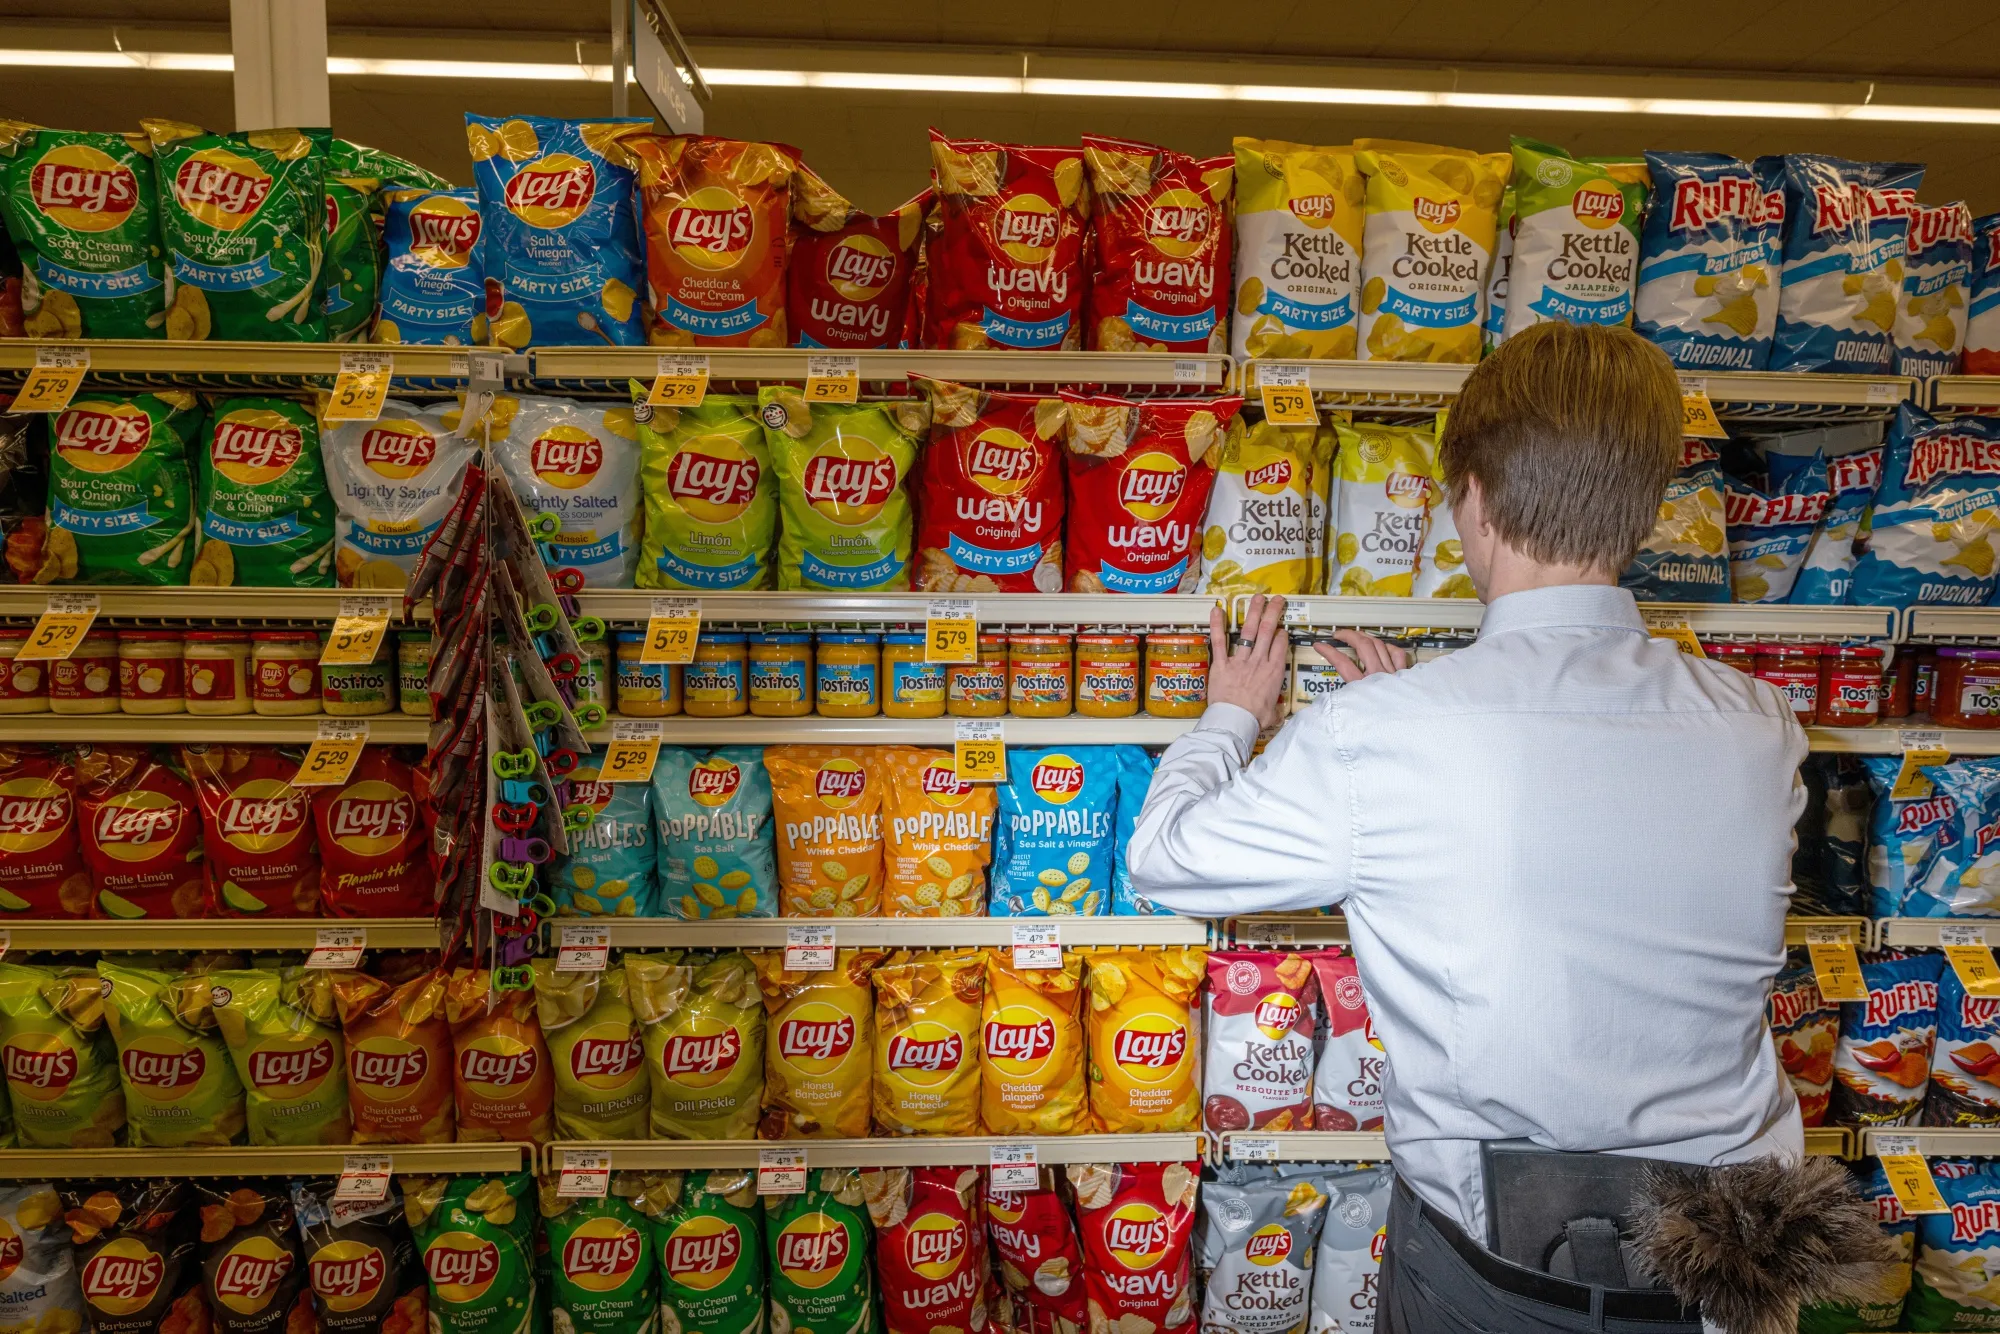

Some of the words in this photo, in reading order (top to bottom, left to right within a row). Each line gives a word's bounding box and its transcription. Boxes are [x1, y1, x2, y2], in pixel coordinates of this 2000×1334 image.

[40, 164, 130, 213] Lay's
[513, 165, 590, 209] Lay's
[1292, 195, 1334, 220] Lay's
[1575, 190, 1622, 218] Lay's
[1672, 178, 1785, 230] RUFFLES
[673, 206, 750, 252] Lay's
[47, 237, 82, 249] Sour
[85, 239, 133, 252] Cream
[530, 235, 555, 247] Salt
[557, 236, 567, 246] &
[1284, 232, 1345, 260] Kettle
[1560, 232, 1630, 260] Kettle
[63, 249, 75, 260] &
[77, 250, 121, 263] Onion
[526, 247, 573, 260] Vinegar
[830, 247, 889, 286] Lay's
[1271, 257, 1350, 283] Cooked
[1547, 257, 1632, 282] Cooked
[48, 269, 101, 290] PARTY
[106, 272, 143, 290] SIZE
[512, 275, 556, 295] PARTY
[561, 275, 593, 294] SIZE
[682, 276, 725, 290] Cheddar
[728, 279, 741, 290] &
[1287, 284, 1338, 295] ORIGINAL
[1565, 282, 1621, 293] JALAPEÑO
[678, 288, 706, 300] Sour
[707, 290, 745, 302] Cream
[673, 308, 719, 329] PARTY
[723, 310, 752, 328] SIZE
[811, 298, 890, 337] wavy
[1272, 301, 1317, 321] PARTY
[1320, 304, 1346, 321] SIZE
[826, 327, 868, 342] Original
[990, 319, 1033, 339] PARTY
[1036, 322, 1065, 339] SIZE
[1679, 342, 1753, 369] ORIGINAL
[59, 410, 147, 455] Lay's
[365, 429, 435, 468] Lay's
[1908, 437, 2000, 482] RUFFLES
[972, 441, 1032, 481] Lay's
[673, 453, 757, 505] Lay's
[1248, 460, 1290, 489] Lay's
[346, 483, 395, 500] Lightly
[399, 484, 440, 499] Salted
[573, 495, 618, 509] Salted
[1965, 492, 1995, 512] Size!
[956, 496, 1042, 533] wavy
[1238, 496, 1301, 523] Kettle
[377, 523, 412, 534] Classic
[690, 531, 732, 547] Limón
[1228, 519, 1303, 544] Cooked
[580, 542, 613, 562] SIZE
[955, 546, 1002, 568] PARTY
[1006, 550, 1038, 568] SIZE
[1245, 547, 1296, 556] ORIGINAL
[1659, 563, 1724, 585] ORIGINAL
[262, 666, 284, 679] Lay's
[692, 767, 741, 796] Lay's
[1036, 766, 1083, 795] Lay's
[99, 806, 173, 845] Lay's
[335, 800, 409, 839] Lay's
[694, 845, 711, 853] Sea
[713, 843, 734, 853] Salt
[806, 847, 828, 856] White
[831, 843, 876, 855] Cheddar
[1019, 840, 1036, 848] Sea
[1038, 840, 1056, 849] Salt
[1058, 840, 1065, 848] &
[1067, 839, 1099, 850] Vinegar
[104, 874, 134, 886] Chile
[137, 872, 174, 884] Limón
[356, 884, 399, 895] Flavored
[1258, 1005, 1300, 1030] Lay's
[988, 1020, 1052, 1062] Lay's
[669, 1031, 738, 1075] Lay's
[892, 1035, 959, 1072] Lay's
[1243, 1041, 1307, 1068] Kettle
[355, 1049, 422, 1088] Lay's
[908, 1092, 942, 1105] Honey
[1000, 1082, 1043, 1093] Cheddar
[1000, 1091, 1044, 1104] Jalapeño
[1236, 1084, 1290, 1096] MESQUITE
[144, 1105, 191, 1118] Limón
[674, 1100, 696, 1112] Dill
[698, 1096, 736, 1109] Pickle
[900, 1099, 950, 1110] Barbecue
[1110, 1219, 1166, 1257] Lay's
[1248, 1233, 1291, 1257] Lay's
[568, 1233, 637, 1275] Lay's
[88, 1257, 158, 1299] Lay's
[903, 1268, 977, 1309] wavy
[1236, 1269, 1300, 1295] Kettle
[572, 1302, 597, 1312] Sour
[599, 1299, 634, 1310] Cream
[925, 1301, 965, 1320] Original
[1225, 1288, 1304, 1311] Cooked
[99, 1319, 153, 1331] Barbecue
[583, 1311, 591, 1320] &
[593, 1308, 624, 1319] Onion
[1225, 1314, 1268, 1327] CRACKED
